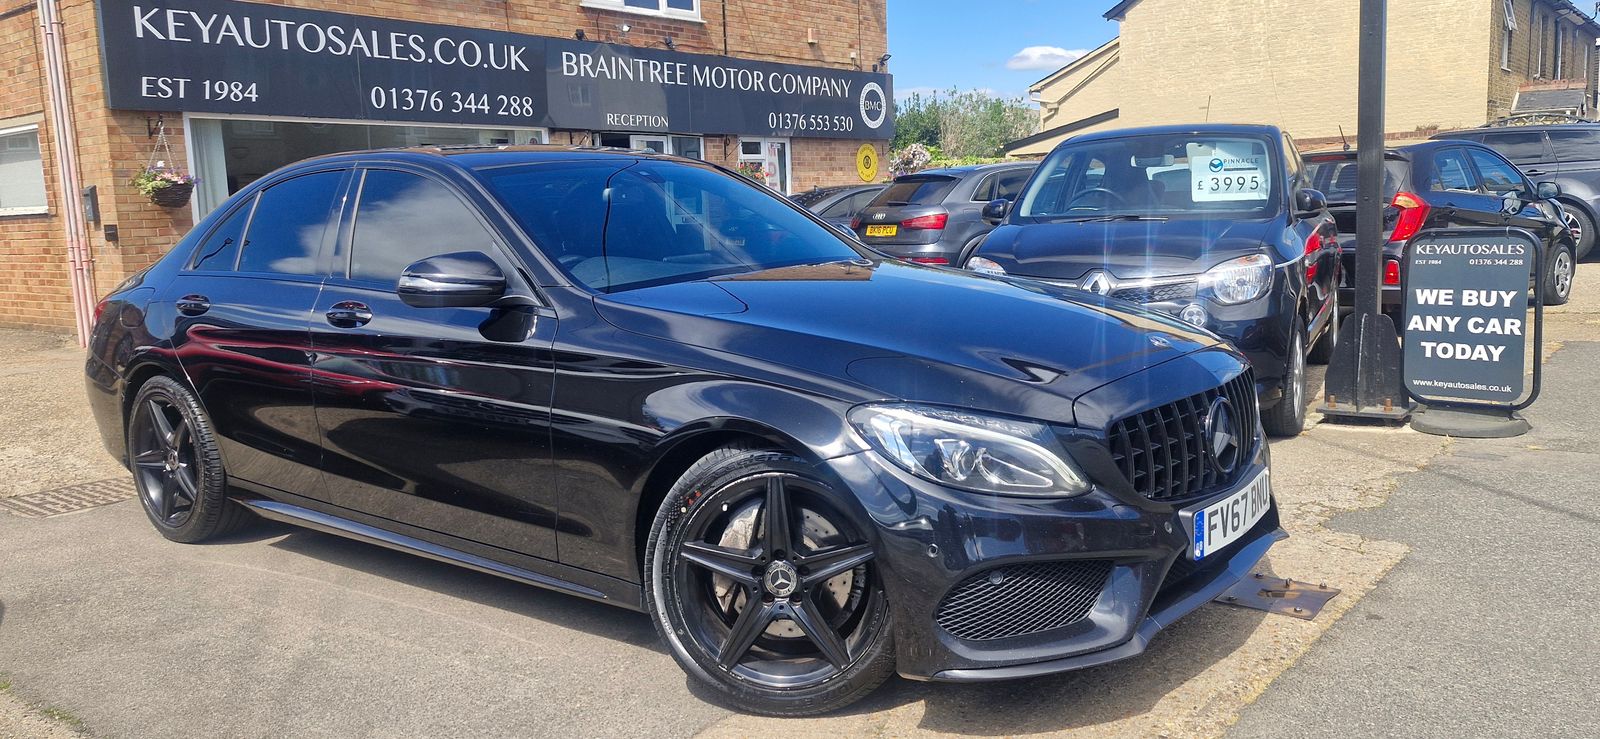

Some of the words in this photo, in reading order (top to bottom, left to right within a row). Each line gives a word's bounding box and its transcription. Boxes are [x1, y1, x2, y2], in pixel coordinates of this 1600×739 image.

[133, 5, 530, 72] KEYAUTOSALES.CO.UK
[562, 51, 688, 86] BRAINTREE
[692, 64, 765, 92] MOTOR
[768, 72, 852, 98] COMPANY
[141, 76, 191, 99] EST
[202, 79, 258, 103] 1984
[370, 86, 444, 112] 01376
[451, 91, 490, 115] 344
[497, 94, 534, 117] 288
[864, 100, 882, 111] BMC
[606, 113, 669, 128] RECEPTION
[768, 112, 807, 130] 01376
[809, 114, 830, 131] 553
[833, 115, 854, 132] 530
[1197, 180, 1204, 191] £
[1210, 176, 1259, 191] 3995
[1416, 244, 1525, 255] KEYAUTOSALES
[1415, 288, 1454, 306] WE
[1462, 289, 1518, 308] BUY
[1407, 314, 1462, 333] ANY
[1467, 317, 1522, 336] CAR
[1420, 341, 1506, 362] TODAY
[1412, 379, 1512, 393] www.keyautosales.co.uk
[1207, 492, 1248, 546] FV67
[1251, 474, 1268, 519] BNU
